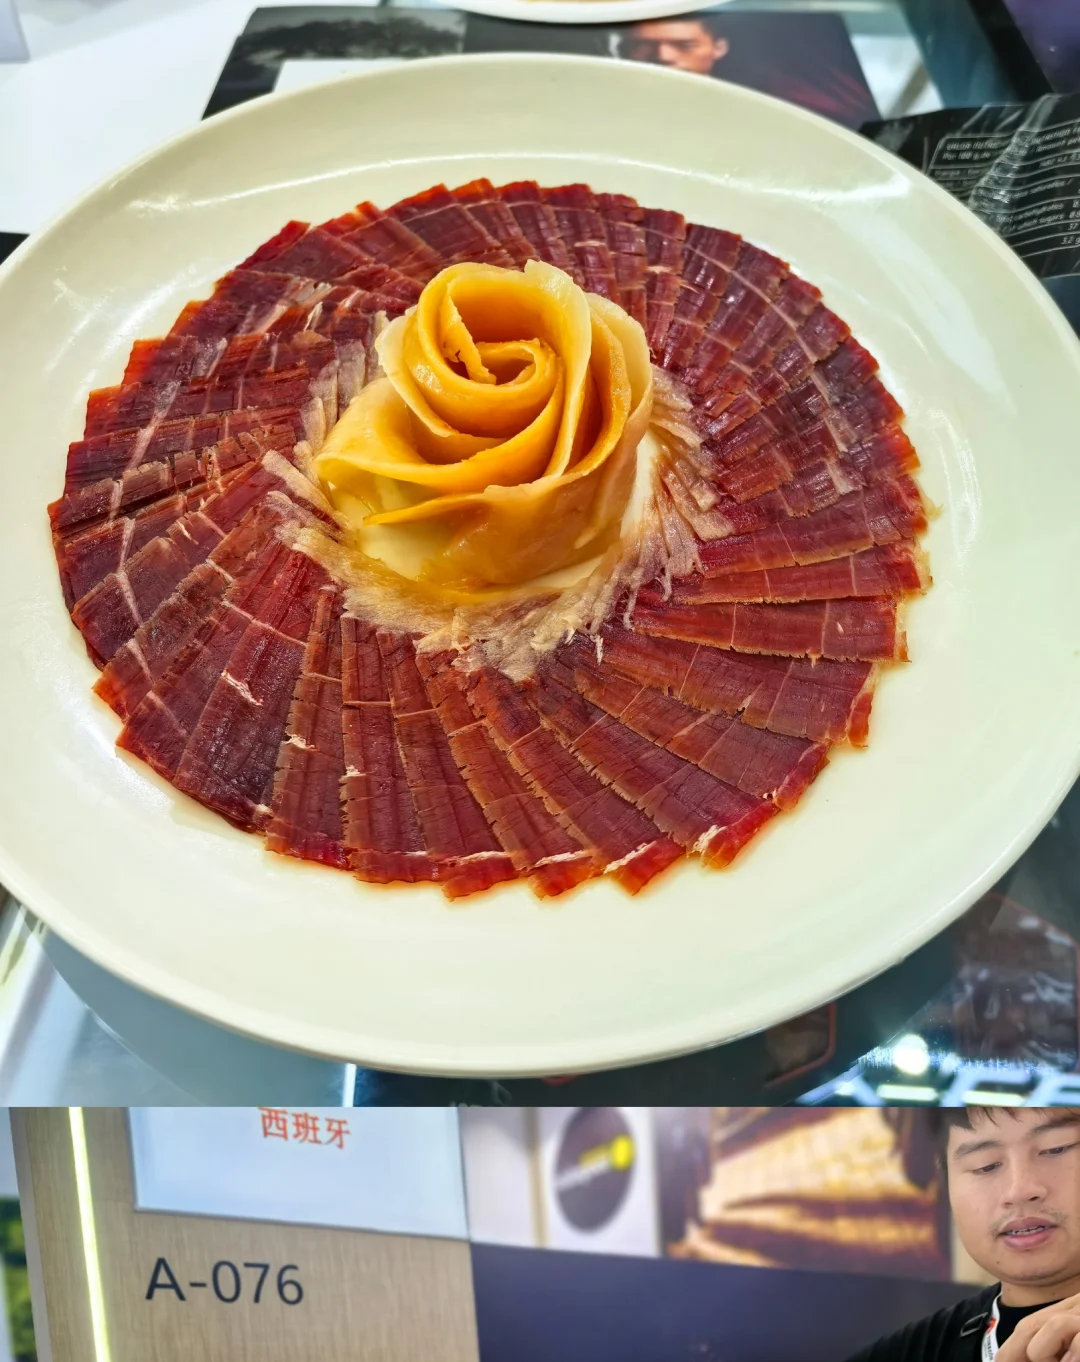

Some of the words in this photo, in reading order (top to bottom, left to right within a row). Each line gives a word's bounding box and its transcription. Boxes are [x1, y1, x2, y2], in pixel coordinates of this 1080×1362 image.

[257, 1107, 351, 1149] 西班牙
[145, 1257, 304, 1305] A-076
